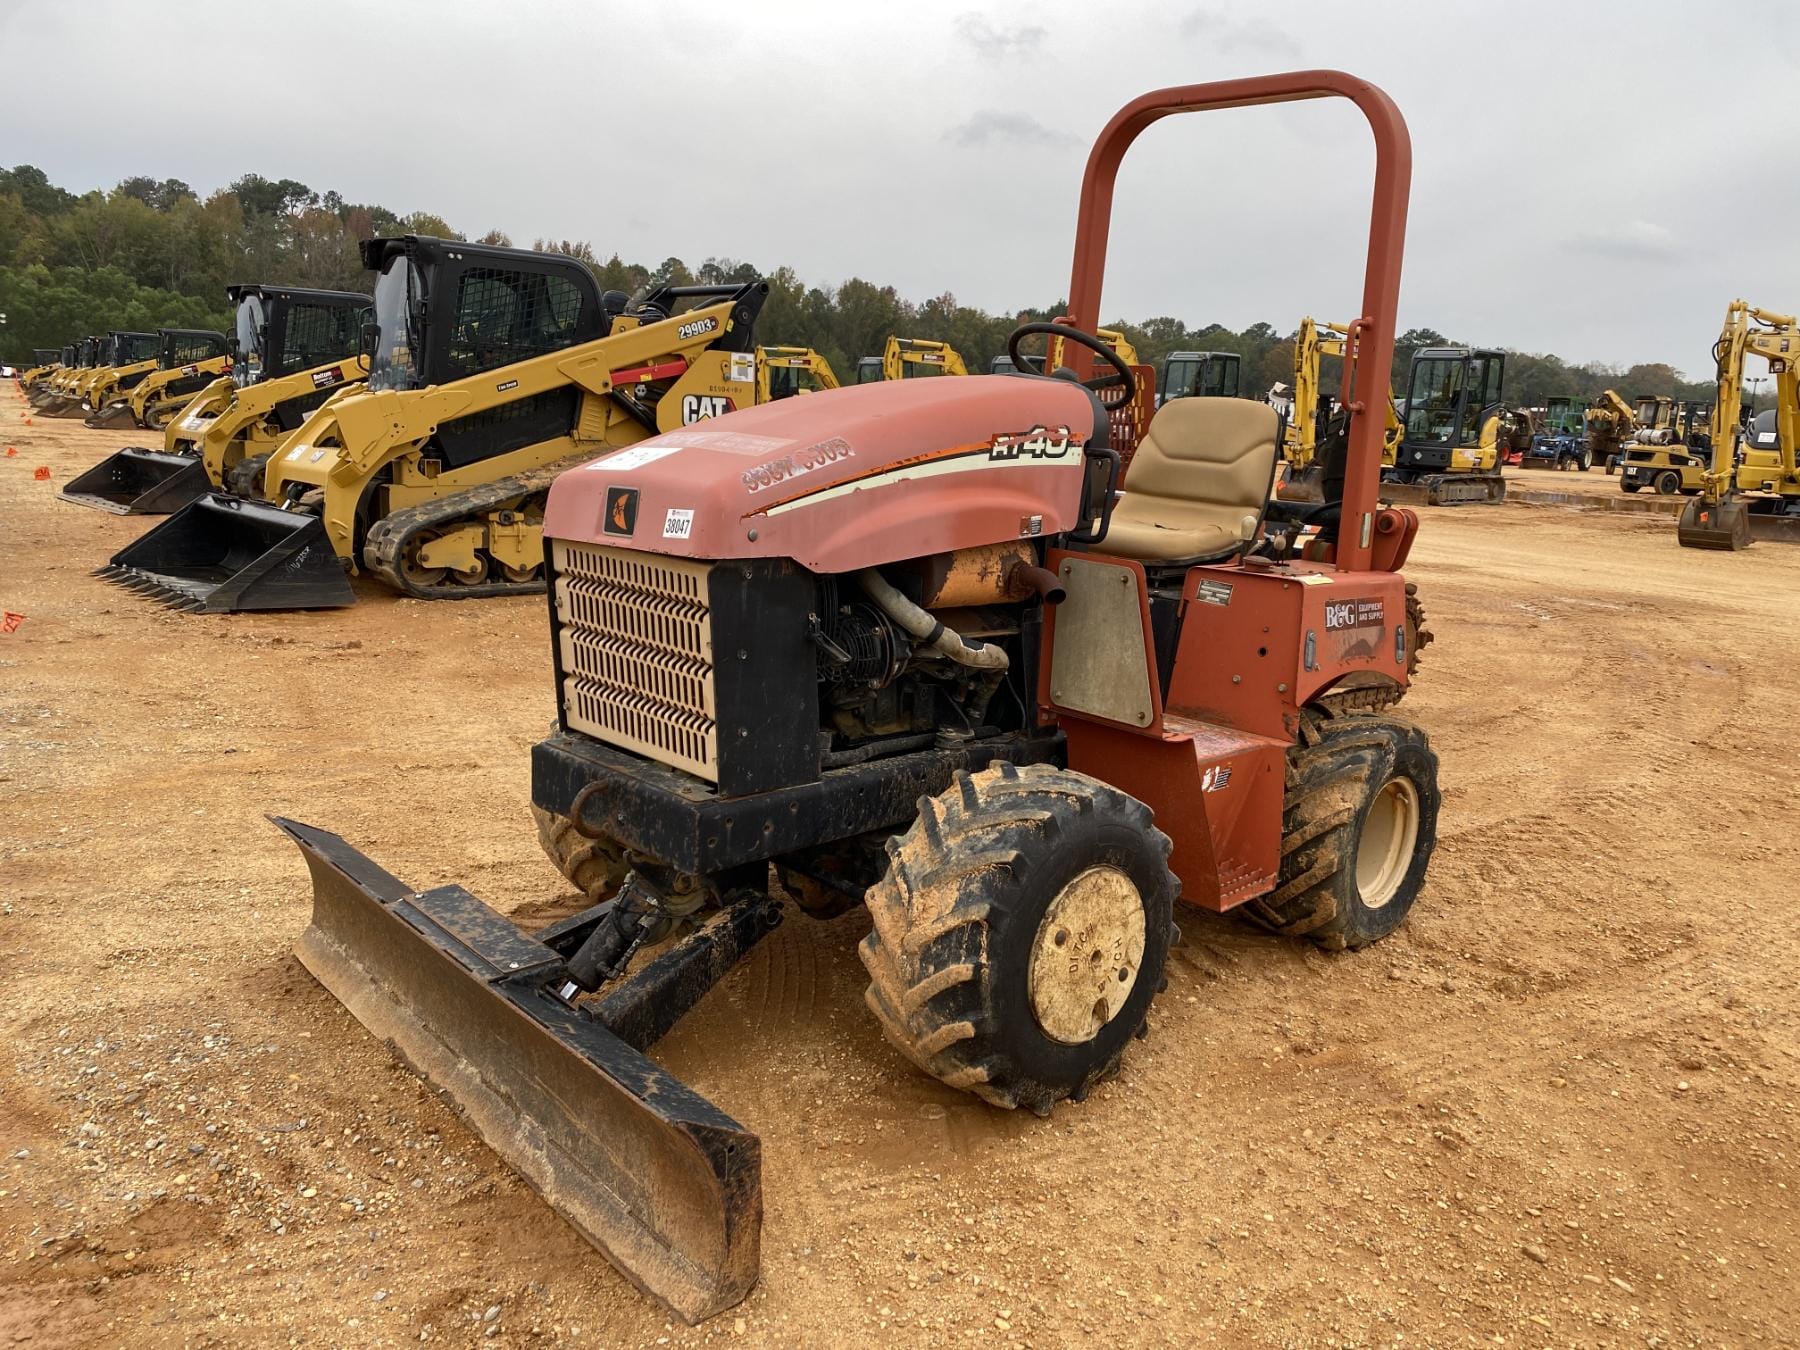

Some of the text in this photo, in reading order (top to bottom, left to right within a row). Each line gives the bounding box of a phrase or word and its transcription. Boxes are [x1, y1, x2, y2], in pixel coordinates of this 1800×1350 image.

[678, 318, 712, 340] 299D3
[683, 395, 727, 426] CAT
[665, 518, 690, 535] 38047
[1326, 603, 1355, 628] B&G
[1358, 602, 1383, 612] EQUIPMENT
[1358, 611, 1384, 621] AND SUPPLY
